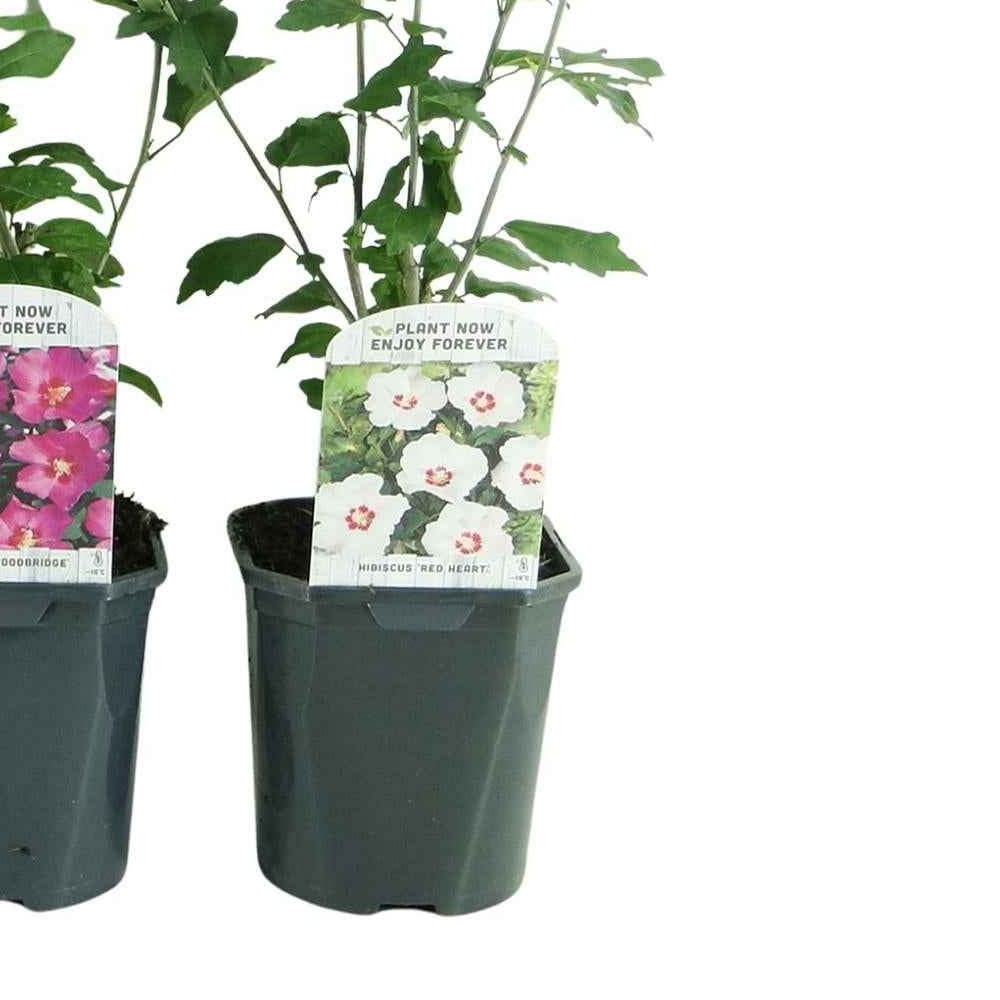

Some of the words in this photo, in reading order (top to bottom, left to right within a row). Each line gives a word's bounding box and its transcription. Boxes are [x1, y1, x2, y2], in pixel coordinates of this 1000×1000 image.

[16, 306, 52, 318] NOW
[396, 323, 450, 334] PLANT
[456, 323, 494, 334] NOW
[371, 339, 425, 350] ENJOY
[432, 338, 507, 350] FOREVER
[359, 564, 412, 572] HIBISCUS
